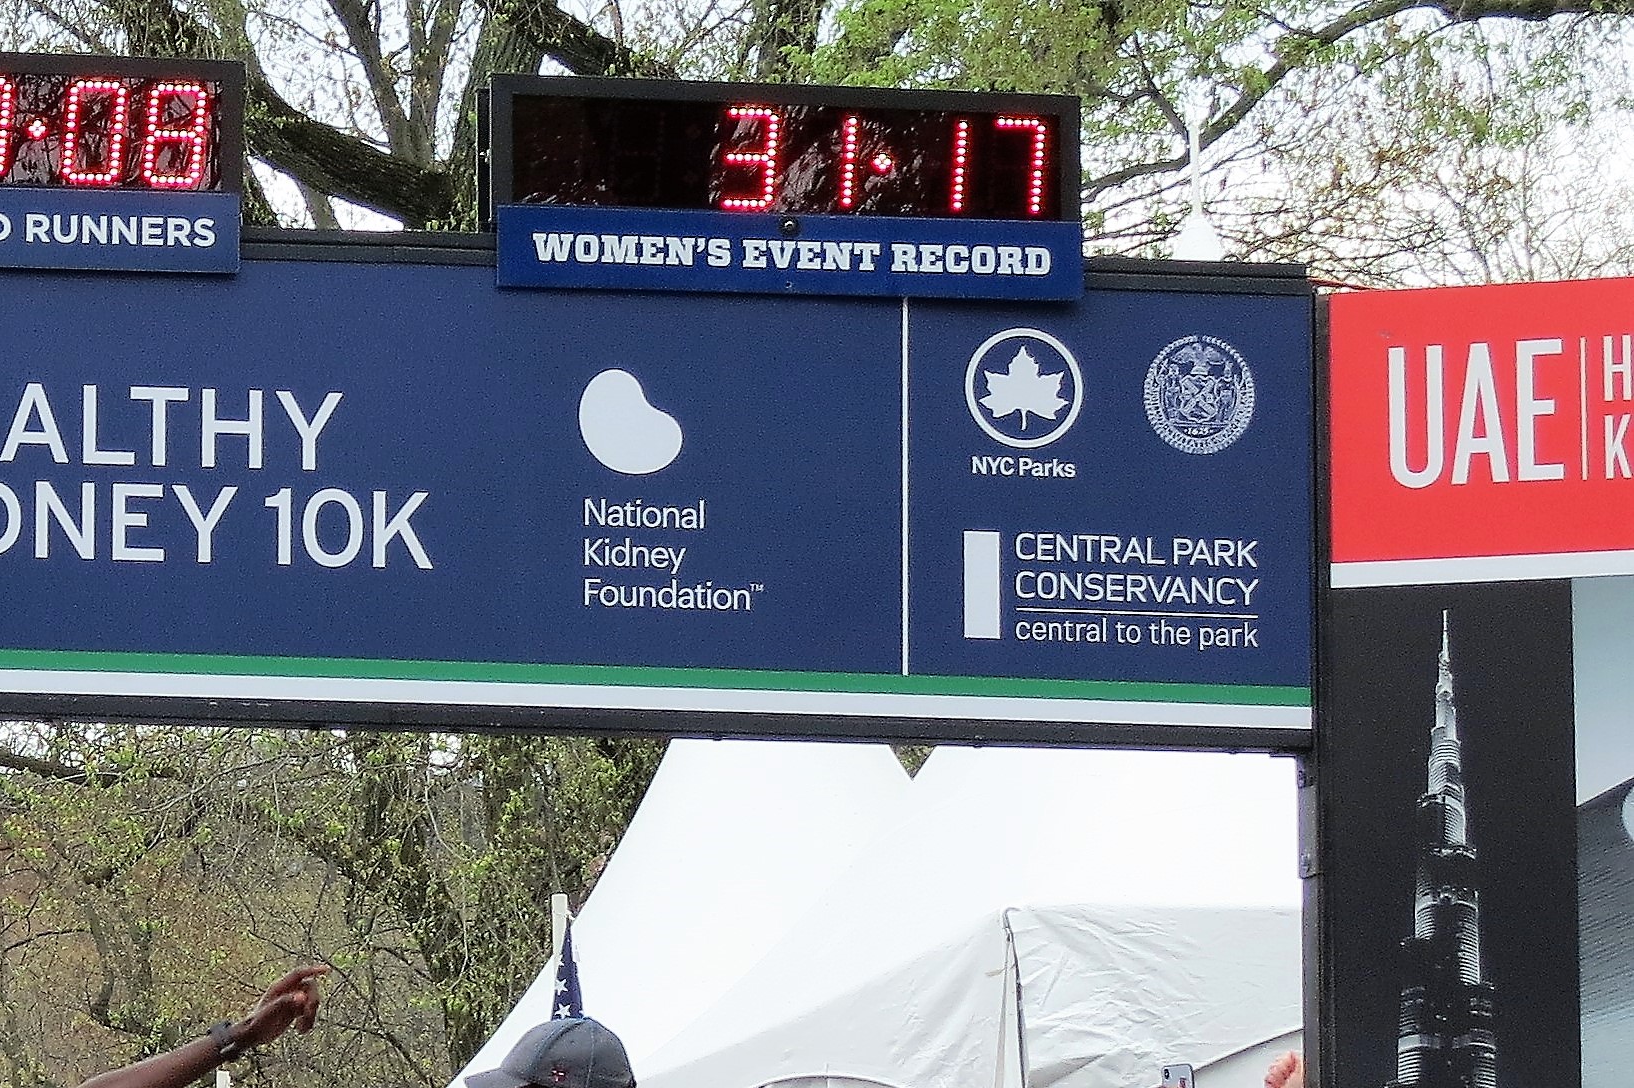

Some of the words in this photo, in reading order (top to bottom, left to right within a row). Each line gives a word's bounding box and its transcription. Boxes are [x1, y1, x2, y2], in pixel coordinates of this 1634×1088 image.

[25, 213, 215, 247] RUNNERS
[742, 239, 881, 271] EVENT
[890, 243, 1051, 275] RECORD
[1388, 338, 1565, 489] UAE
[971, 455, 1015, 476] NYC
[1018, 457, 1076, 478] Parks
[264, 487, 434, 570] 10K
[584, 498, 705, 529] National
[584, 537, 687, 575] Kidney
[1015, 532, 1166, 565] CENTRAL
[1173, 538, 1258, 568] PARK
[1015, 570, 1259, 606] CONSERVANCY
[1015, 617, 1107, 643] central
[1114, 621, 1142, 644] to
[1148, 619, 1191, 646] the
[1199, 621, 1259, 651] park
